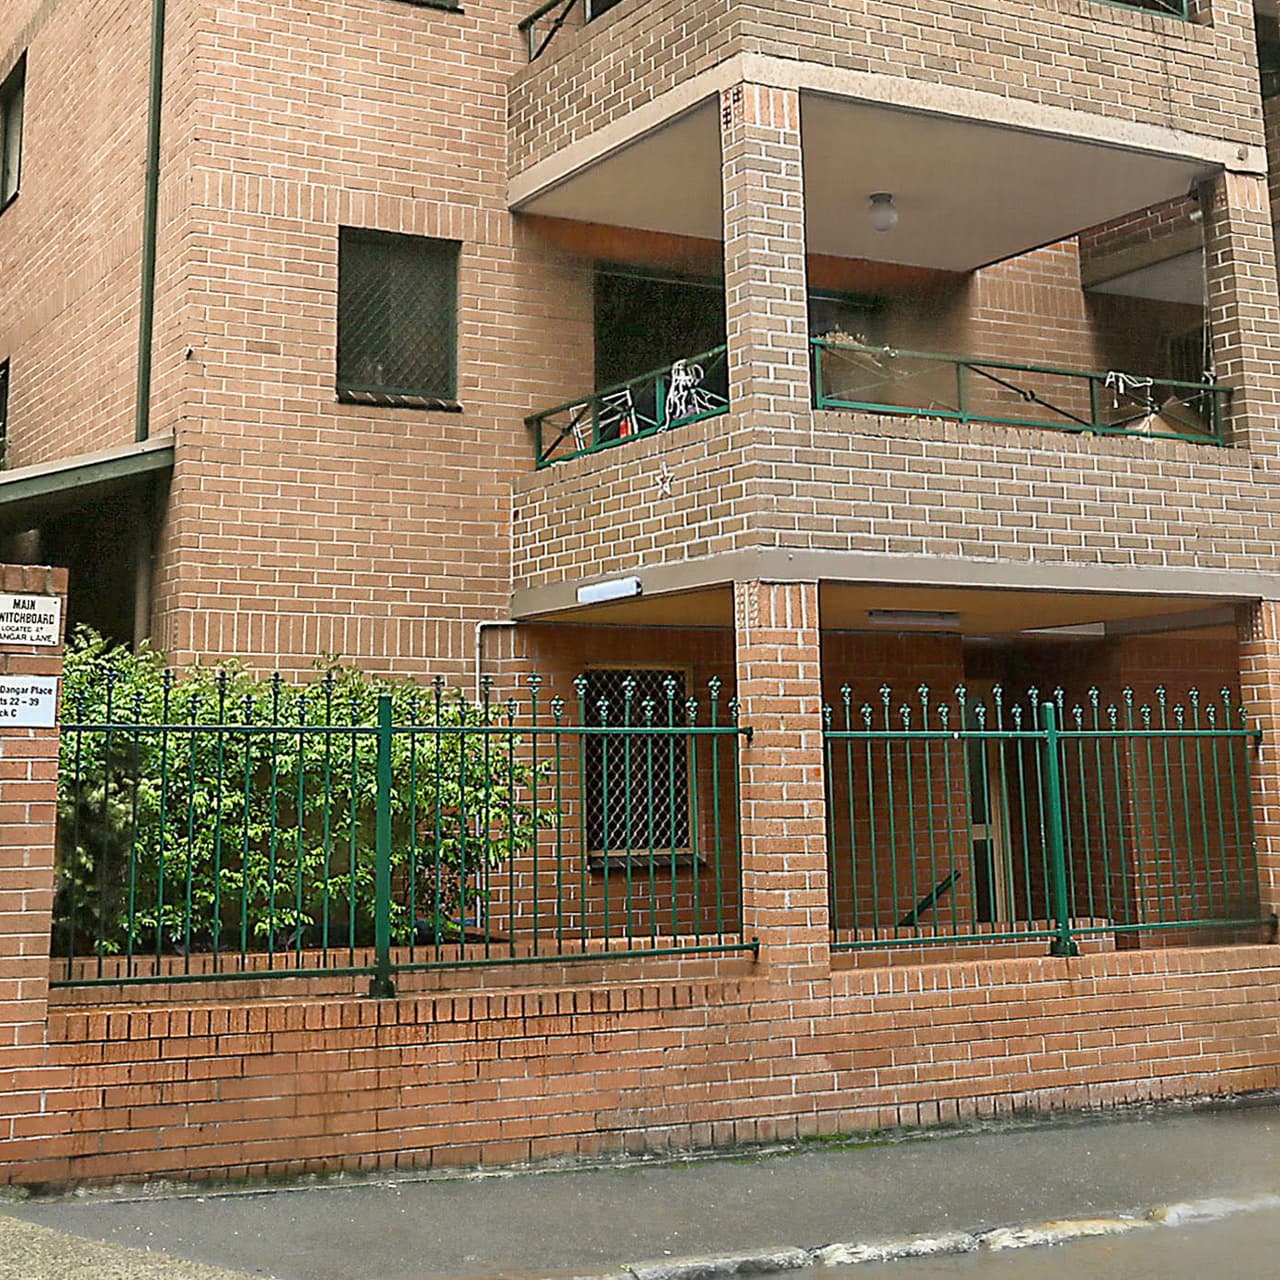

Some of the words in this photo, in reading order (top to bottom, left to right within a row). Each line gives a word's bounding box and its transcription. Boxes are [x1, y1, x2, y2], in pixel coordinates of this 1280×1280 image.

[12, 599, 36, 610] MAIN
[0, 685, 28, 695] Dangar
[30, 686, 52, 694] Place
[10, 697, 20, 706] 22
[29, 698, 39, 706] 39
[10, 708, 17, 717] C
